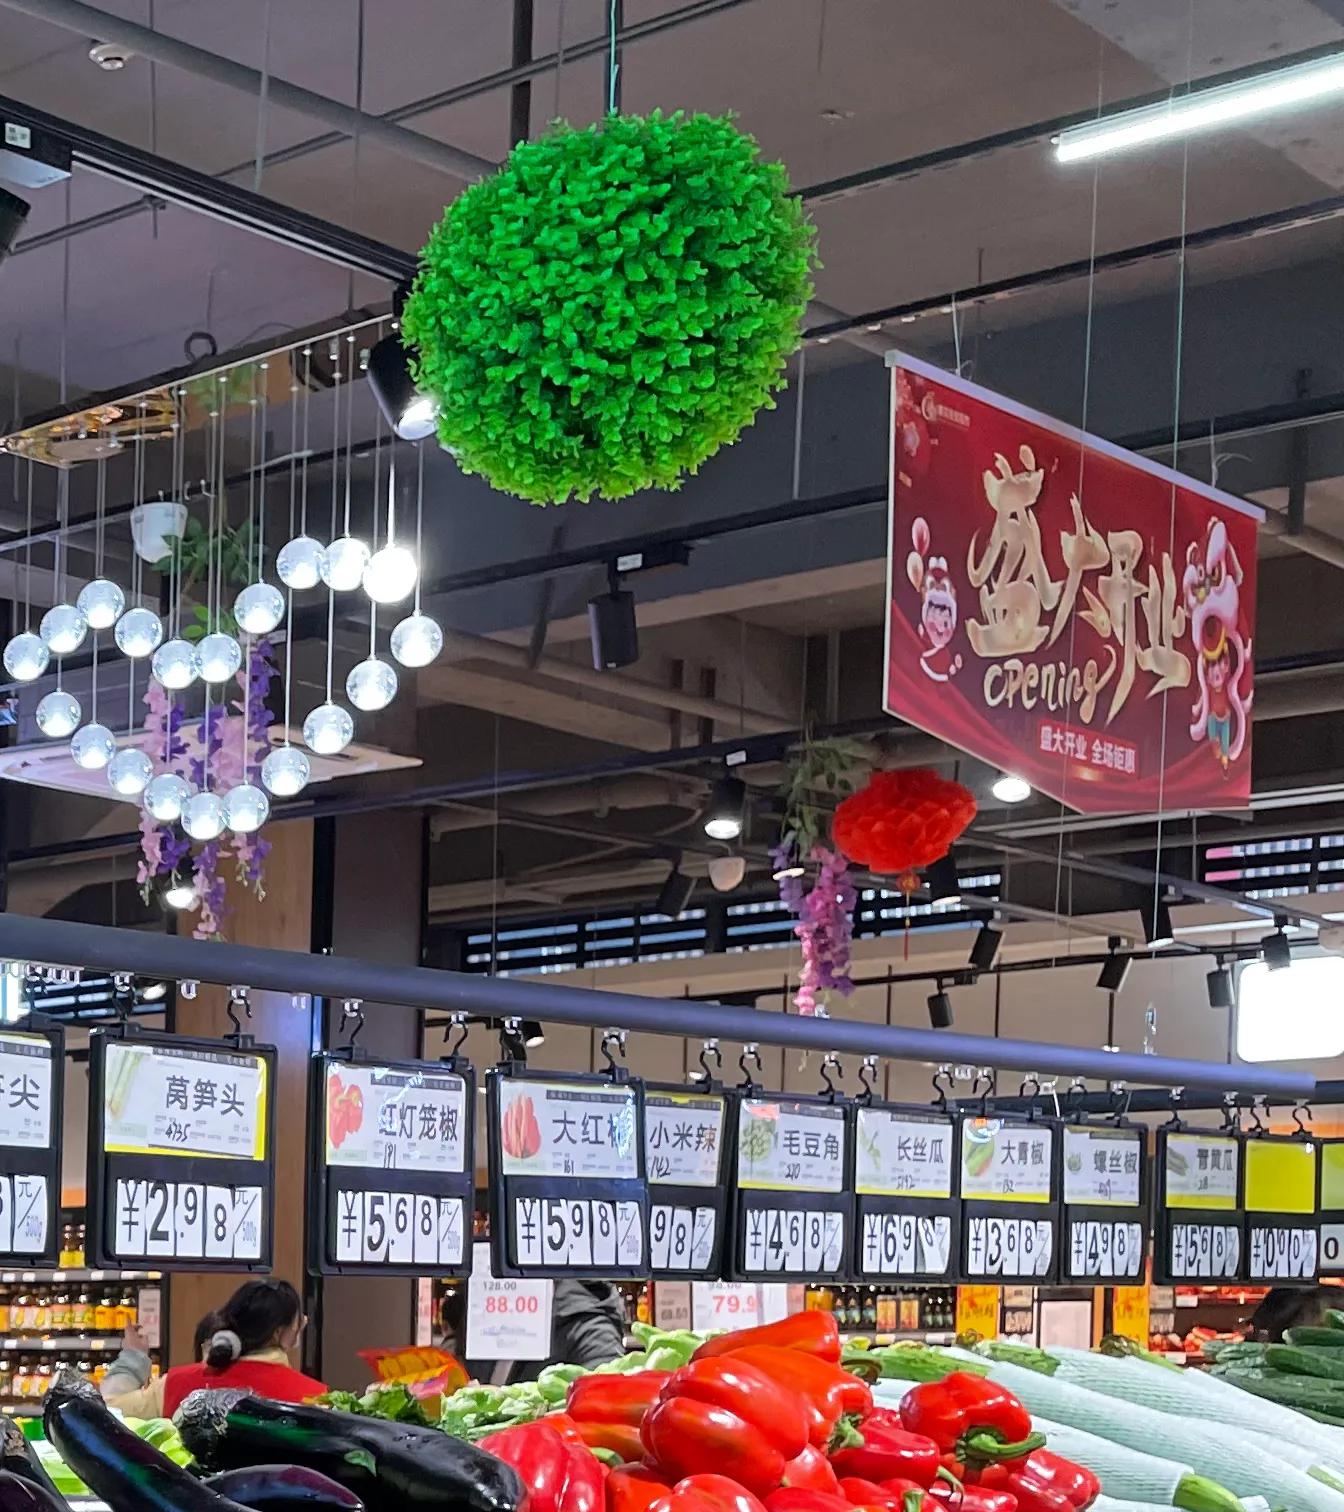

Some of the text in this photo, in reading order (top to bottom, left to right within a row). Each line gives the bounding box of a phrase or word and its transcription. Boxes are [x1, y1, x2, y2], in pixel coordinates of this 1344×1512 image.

[166, 1074, 245, 1118] 莴笋头
[650, 1121, 717, 1152] 小米辣
[783, 1129, 840, 1161] 毛豆角
[896, 1135, 944, 1164] 长丝瓜
[122, 1182, 228, 1243] ¥2.98
[342, 1190, 433, 1252] ¥5.68
[520, 1198, 611, 1253] ¥5.98
[750, 1209, 821, 1260] ¥4.68
[486, 1296, 538, 1313] 88.00
